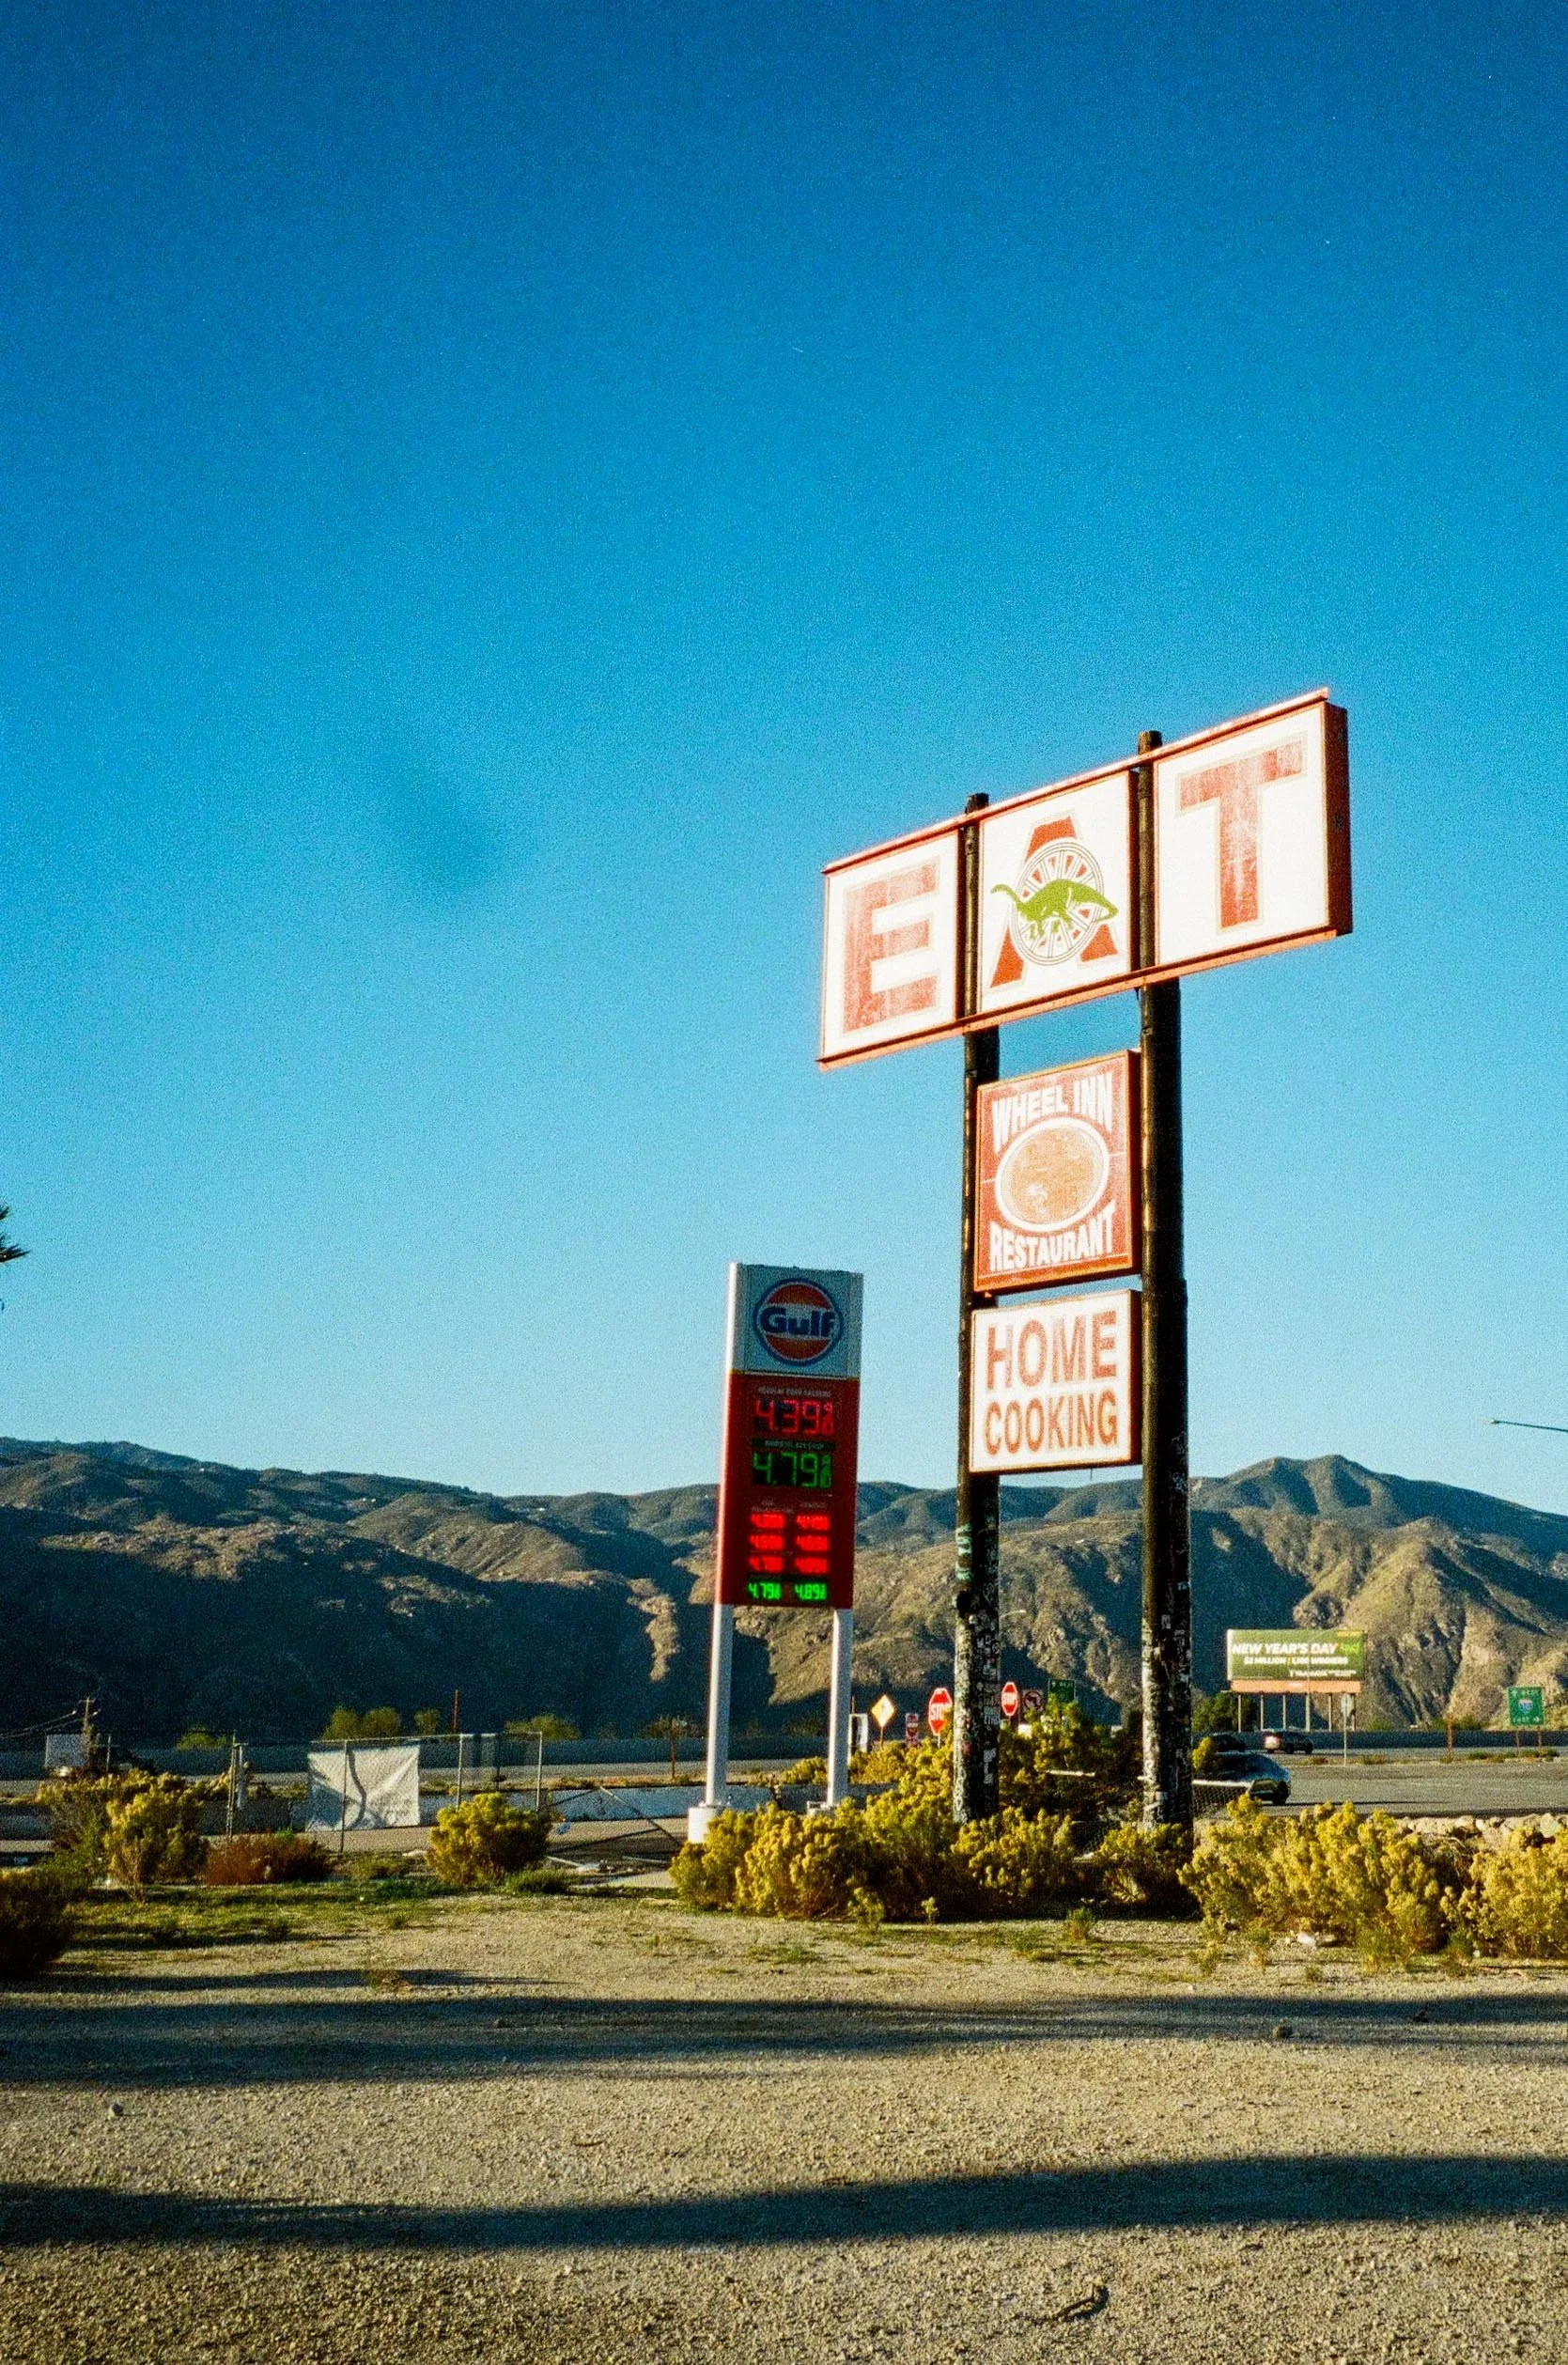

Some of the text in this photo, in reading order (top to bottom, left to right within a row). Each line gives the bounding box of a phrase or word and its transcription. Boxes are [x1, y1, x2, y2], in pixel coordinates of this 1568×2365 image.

[844, 731, 1308, 1034] EAT
[993, 1070, 1114, 1153] WHEEL INN
[989, 1202, 1116, 1272] RESTAURANT
[759, 1304, 837, 1340] Gulf
[986, 1311, 1118, 1390] HOME
[985, 1392, 1119, 1455] COOKING
[1232, 1643, 1262, 1654] NEW
[1265, 1642, 1309, 1654] YEAR'S
[1311, 1642, 1339, 1654] DAY
[1001, 1692, 1017, 1704] STOP
